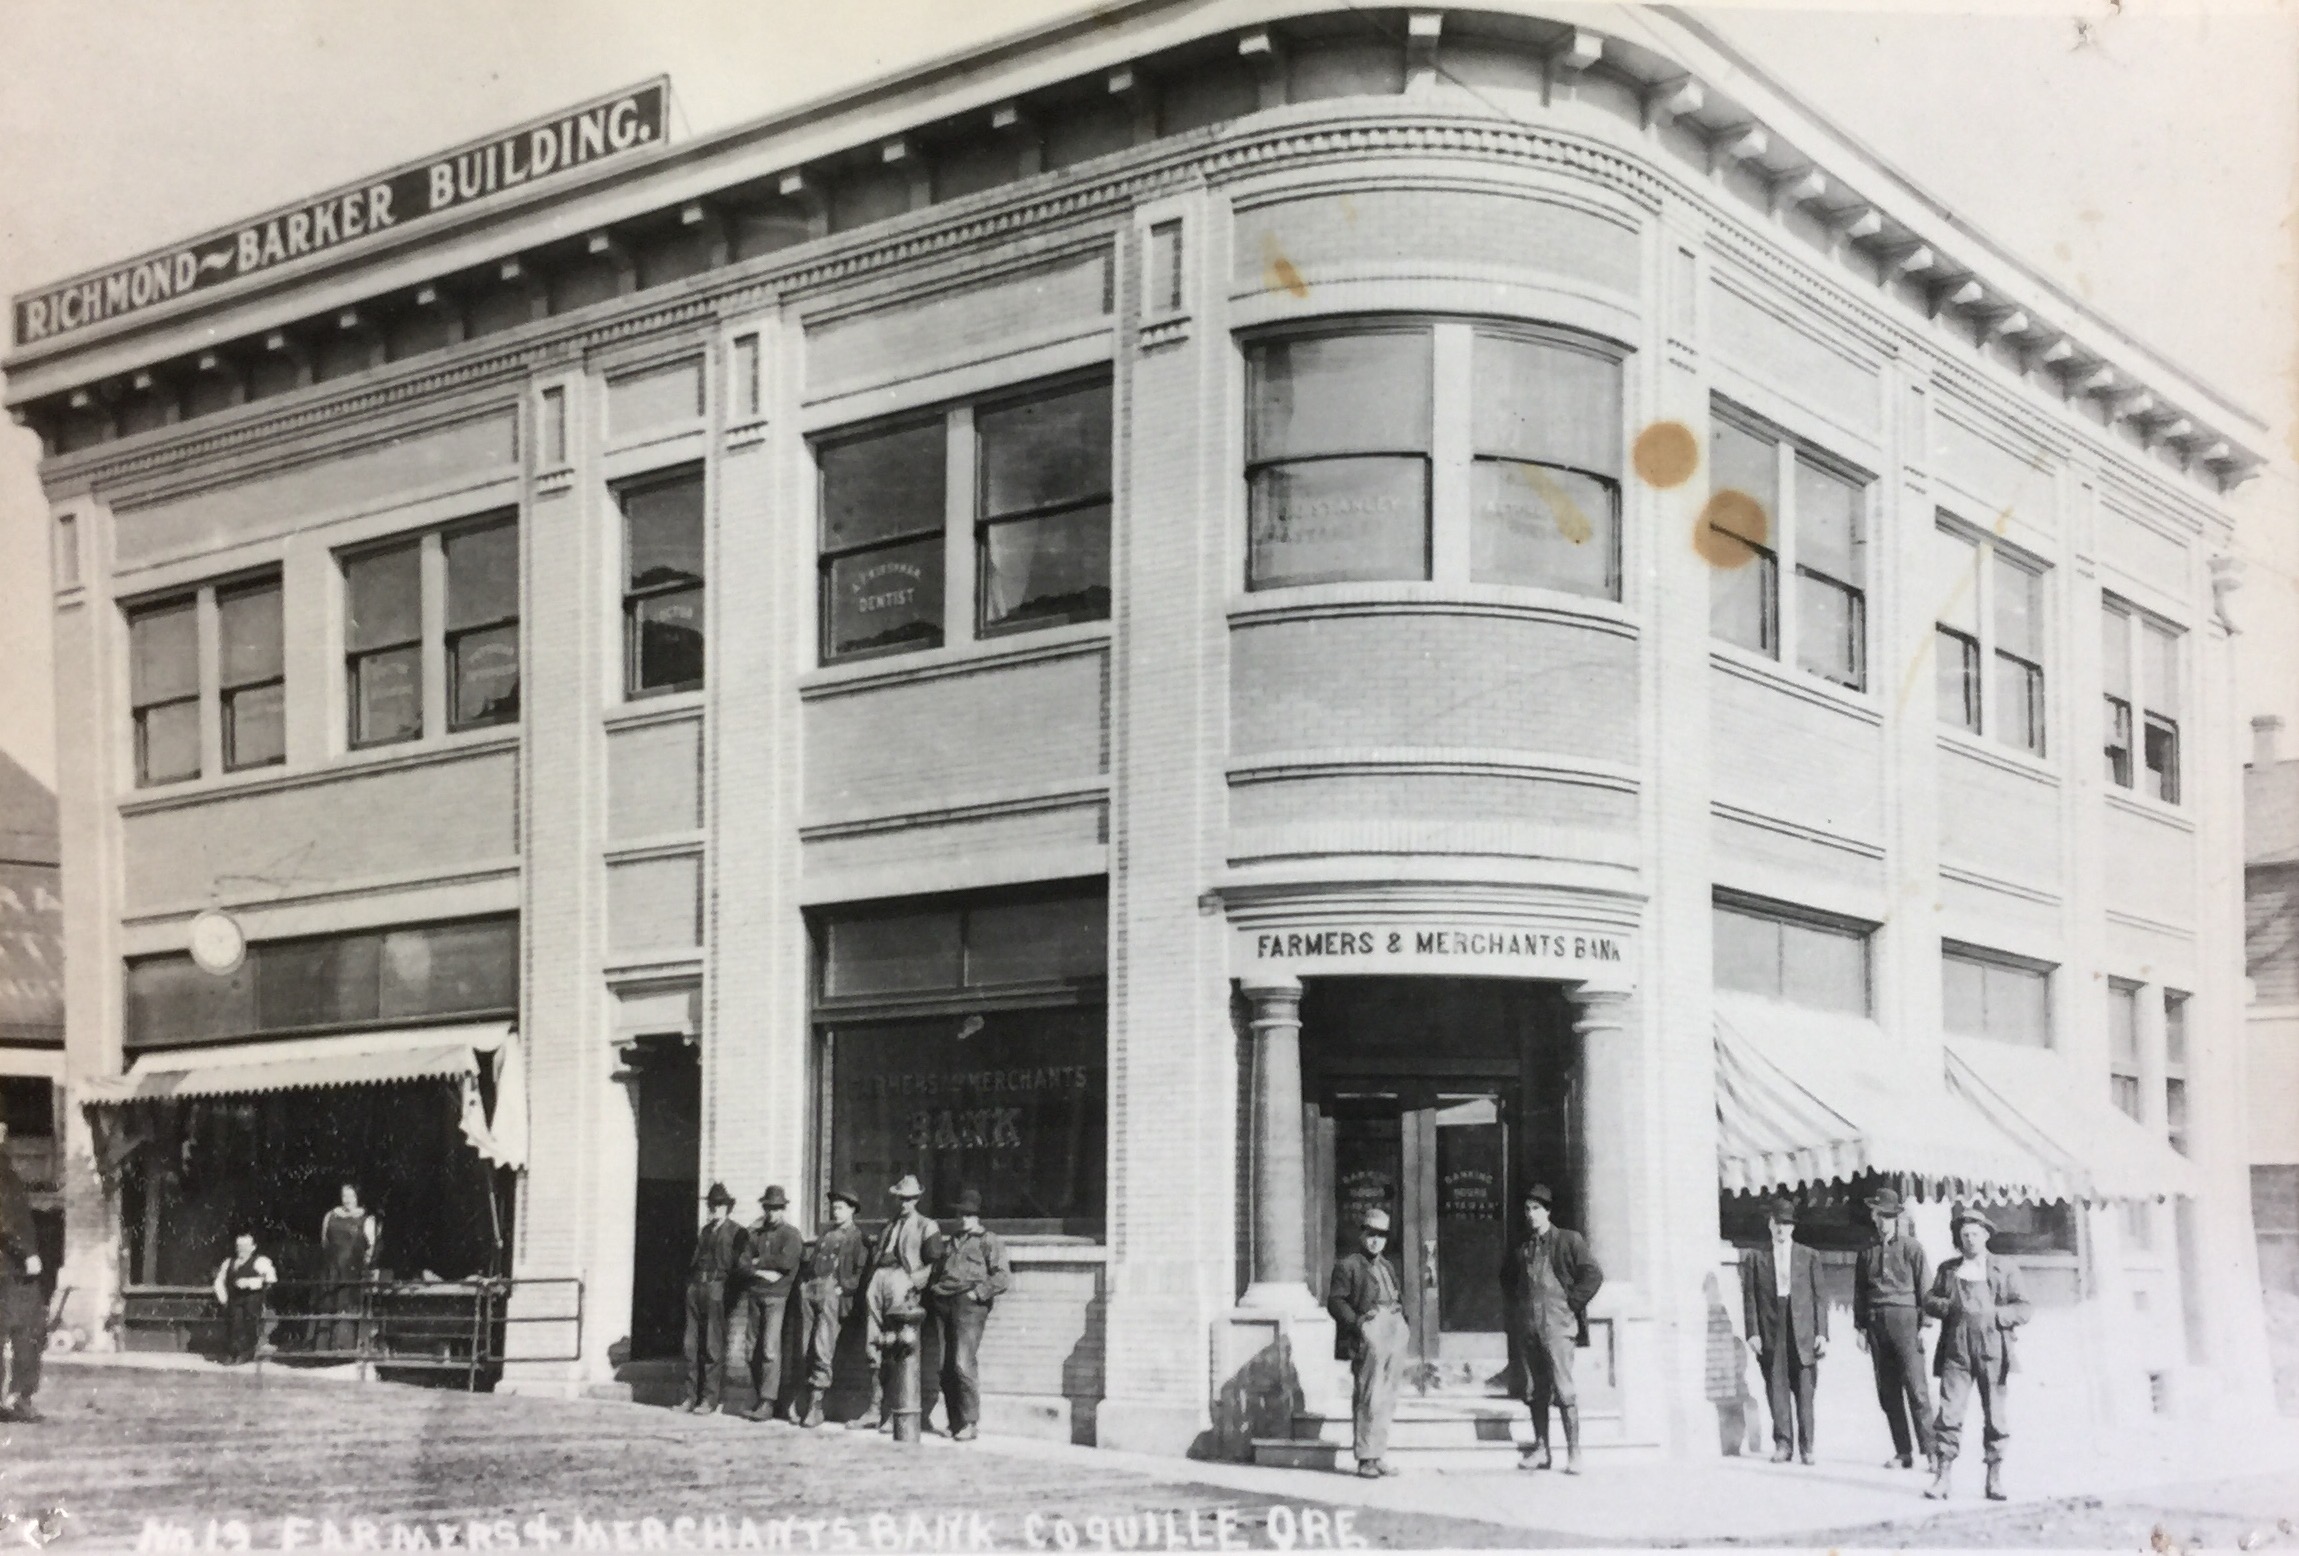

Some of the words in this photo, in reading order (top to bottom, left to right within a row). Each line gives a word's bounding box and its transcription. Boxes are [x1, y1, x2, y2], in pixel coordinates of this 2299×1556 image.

[428, 97, 652, 208] BUILDING.
[859, 587, 915, 612] DENTIST
[1257, 931, 1374, 959] FARMERS
[1385, 931, 1403, 954] &
[1415, 931, 1566, 957] MERCHANTS
[1574, 936, 1621, 961] BANK
[850, 1072, 938, 1096] RMERS
[967, 1064, 1088, 1093] MERCHANTS
